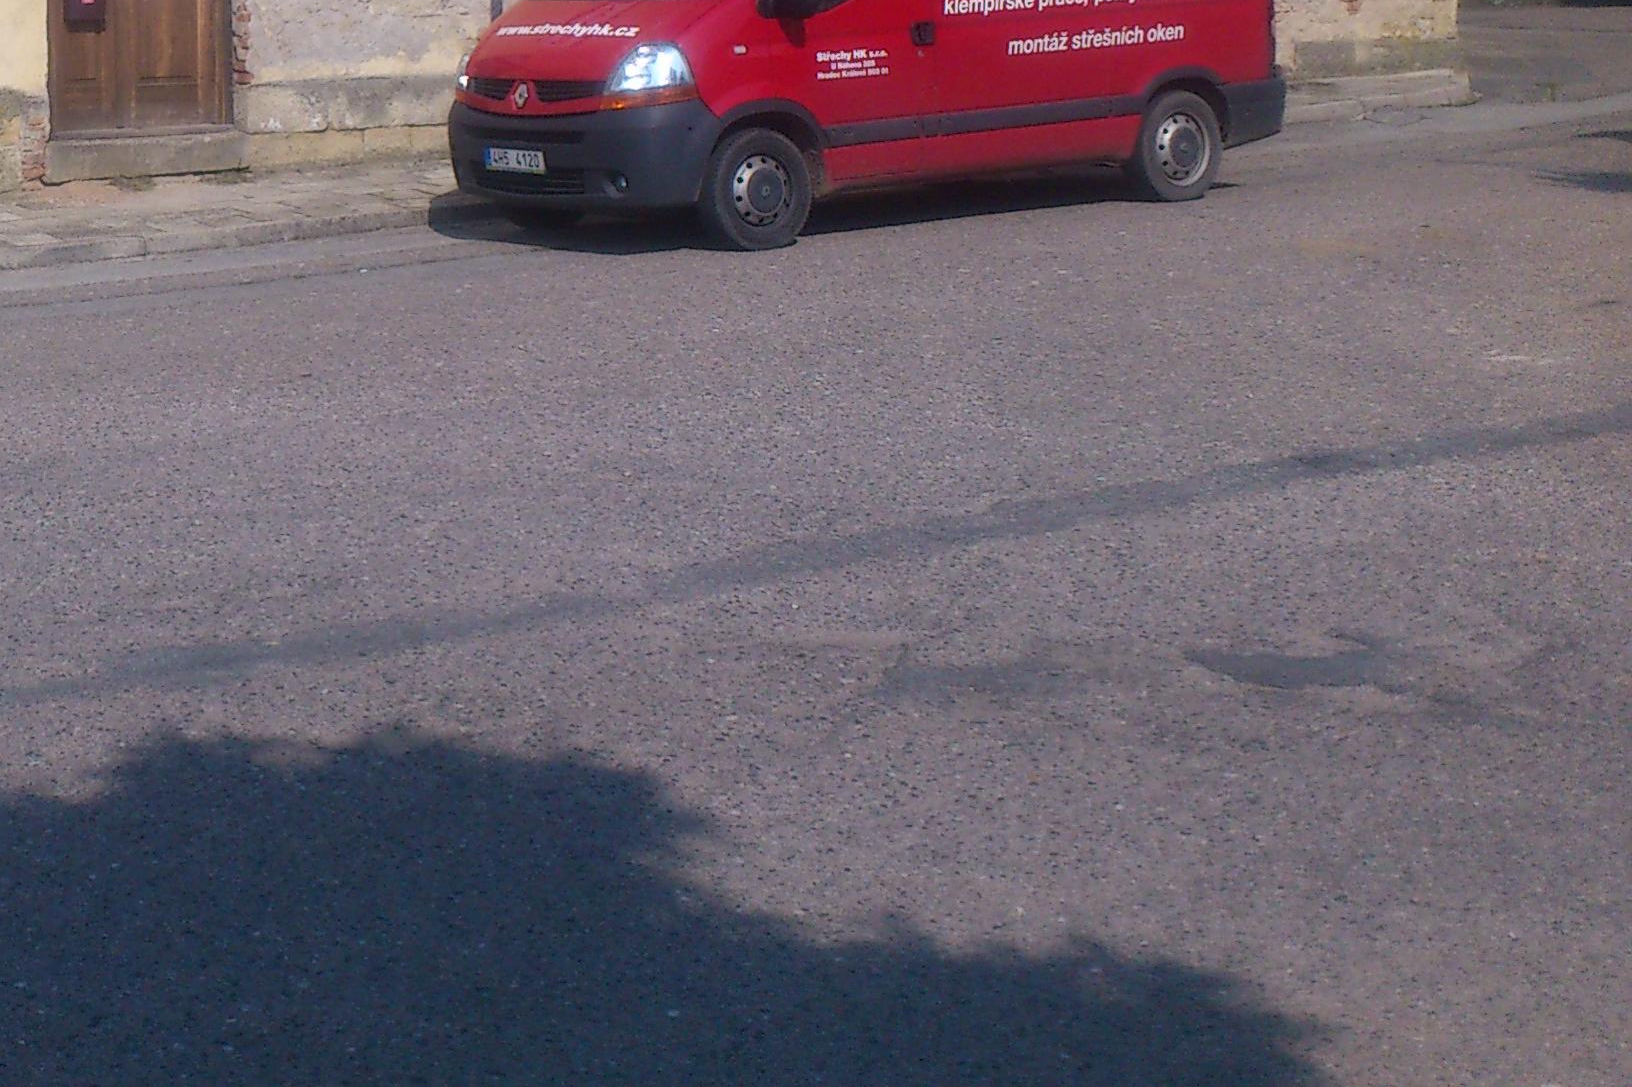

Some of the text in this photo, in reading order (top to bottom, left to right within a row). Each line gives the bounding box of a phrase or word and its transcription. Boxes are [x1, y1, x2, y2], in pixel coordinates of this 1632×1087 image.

[496, 23, 640, 37] www.strechyhk.cz
[1008, 22, 1184, 56] montáž střešních oken
[515, 152, 540, 168] 4120
